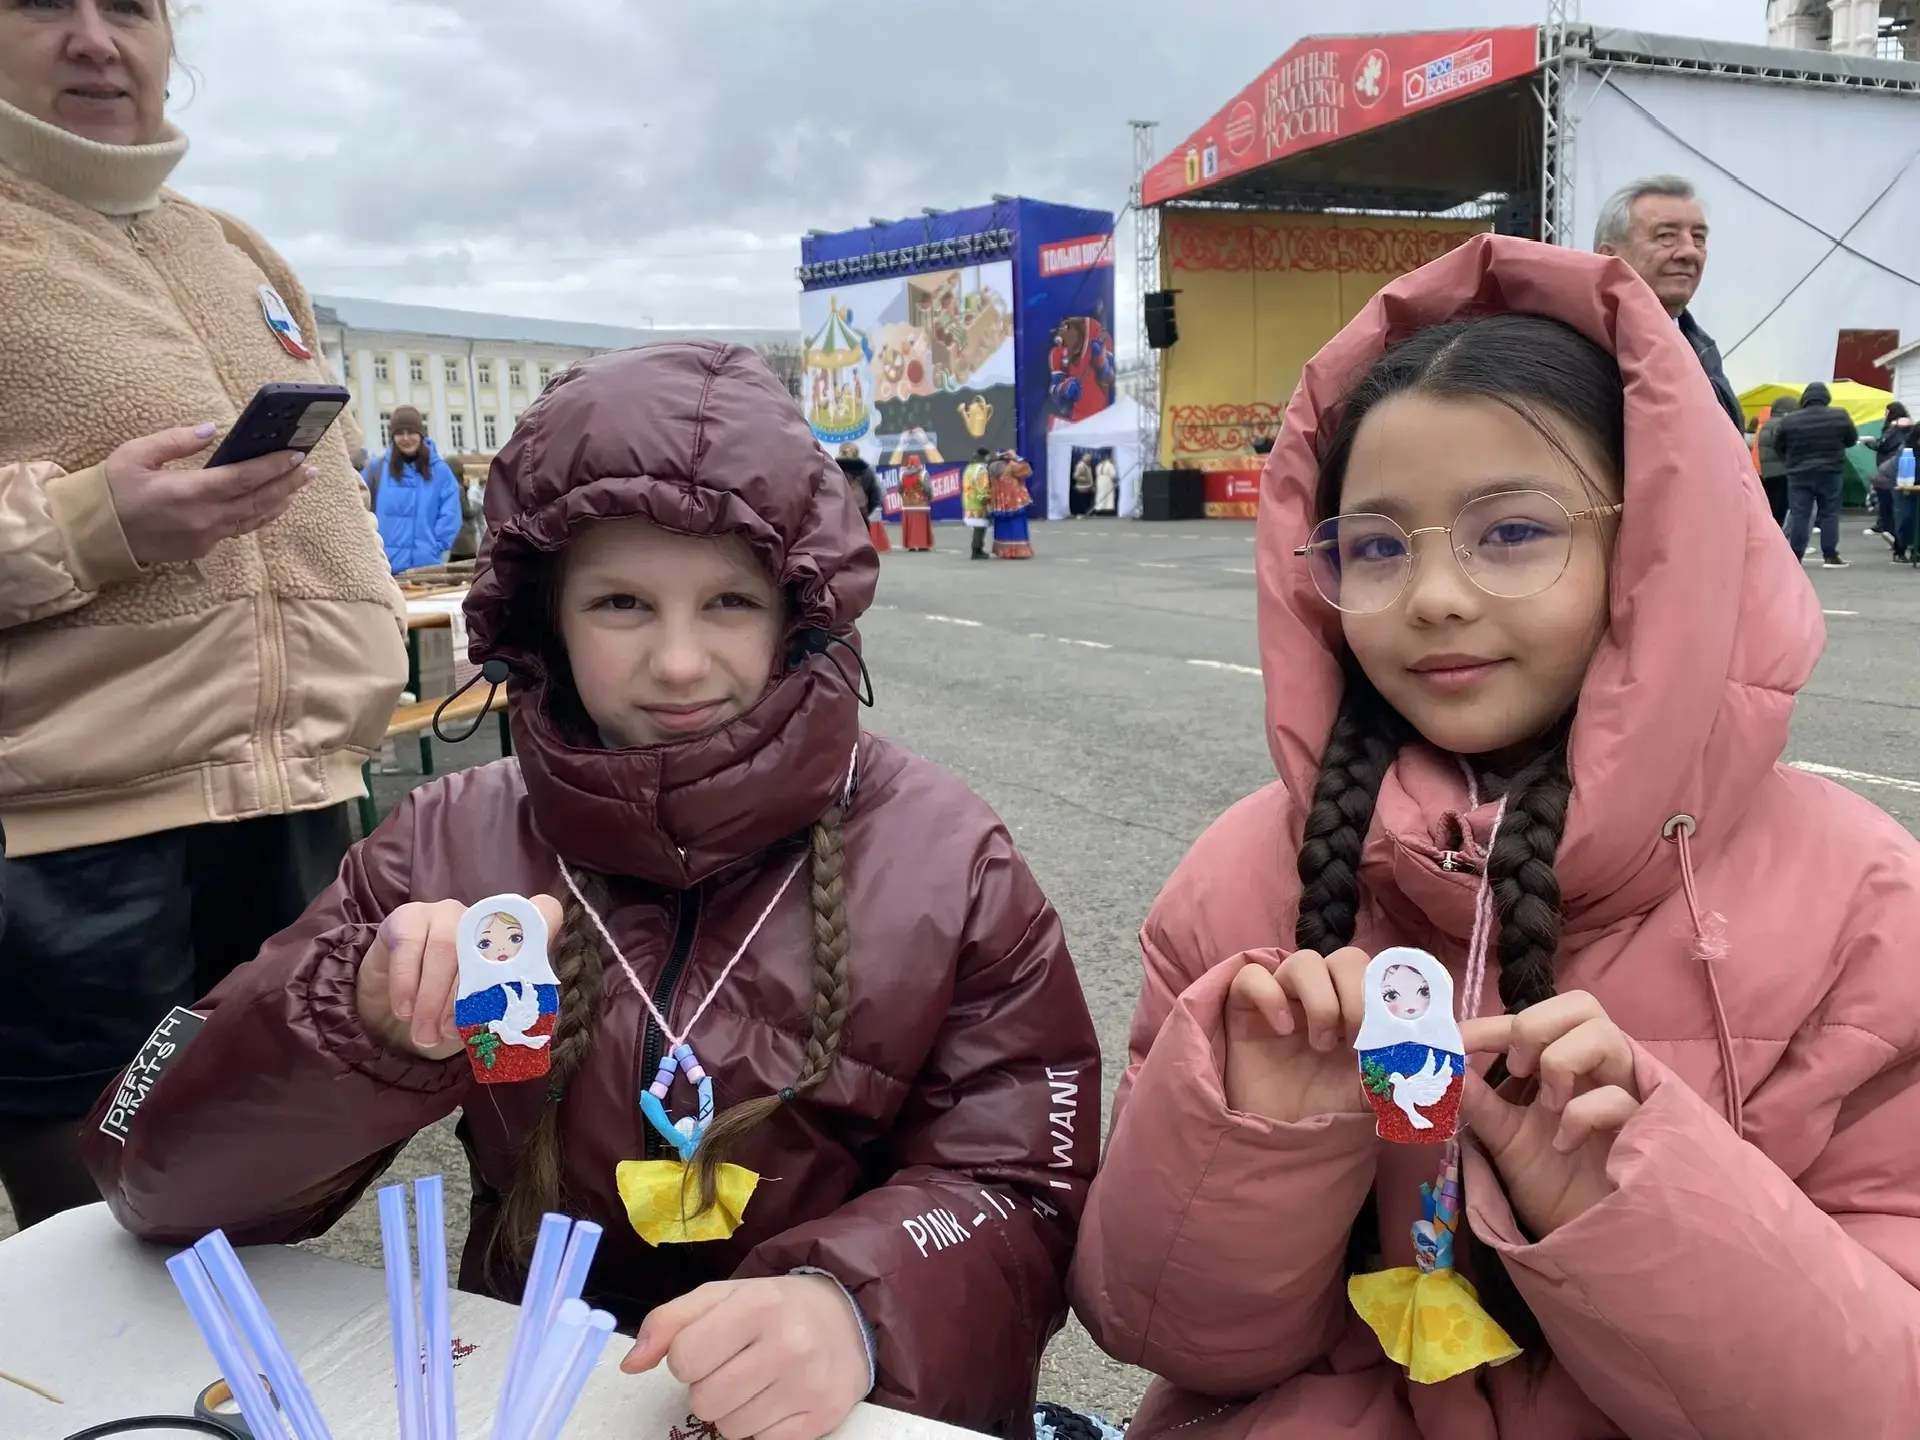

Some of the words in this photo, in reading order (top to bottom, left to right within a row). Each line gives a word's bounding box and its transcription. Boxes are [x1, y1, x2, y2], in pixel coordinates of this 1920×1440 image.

[1428, 57, 1453, 80] РОС
[1428, 61, 1490, 95] КАЧЕСТВО
[1266, 106, 1339, 160] РОССИИ
[1043, 246, 1082, 273] ТОЛЬКО
[108, 1055, 147, 1128] DEFY
[1045, 1066, 1080, 1168] WANT
[902, 1208, 971, 1258] PINK
